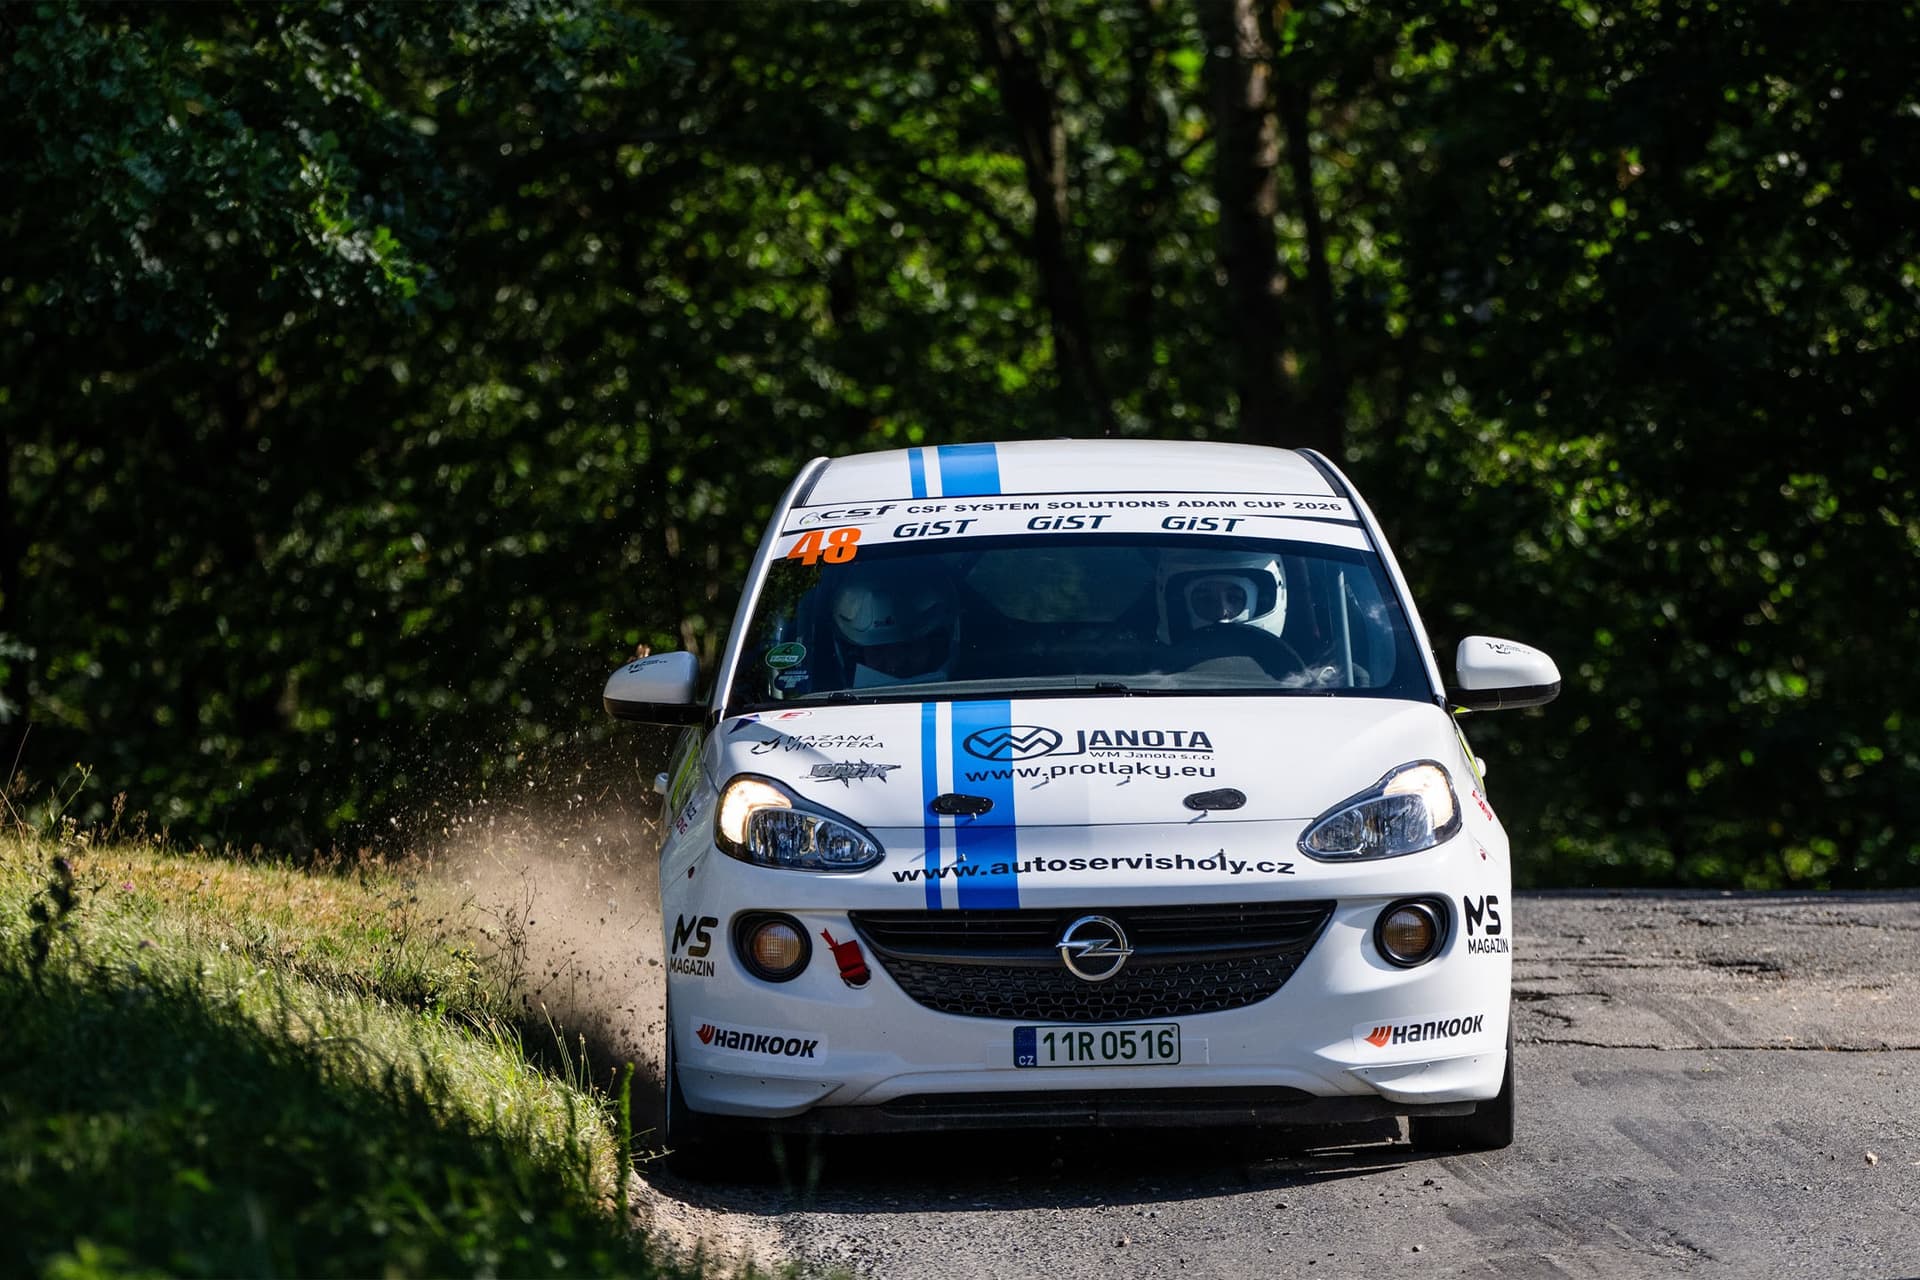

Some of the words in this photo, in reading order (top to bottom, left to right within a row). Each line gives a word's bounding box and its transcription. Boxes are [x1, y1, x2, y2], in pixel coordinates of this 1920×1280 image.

[906, 504, 946, 514] CSF
[954, 502, 1040, 512] SYSTEM
[1047, 500, 1170, 510] SOLUTIONS
[1177, 500, 1237, 508] ADAM
[1243, 501, 1286, 509] CUP
[1292, 501, 1343, 511] 2026
[893, 518, 979, 538] GiST
[1026, 514, 1112, 531] GiST
[1160, 515, 1245, 532] GiST
[786, 527, 862, 566] 48
[785, 741, 884, 753] VINOTEKA
[787, 734, 874, 746] MAZANA
[1077, 729, 1214, 754] JANOTA
[1124, 752, 1176, 760] Janota
[1180, 753, 1215, 761] s.r.o.
[965, 761, 1216, 783] www.protlaky.eu
[892, 851, 1296, 883] www.autoservisholy.cz
[1467, 938, 1509, 955] MAGAZIN
[669, 956, 715, 977] MAGAZIN
[1018, 1055, 1034, 1066] CZ
